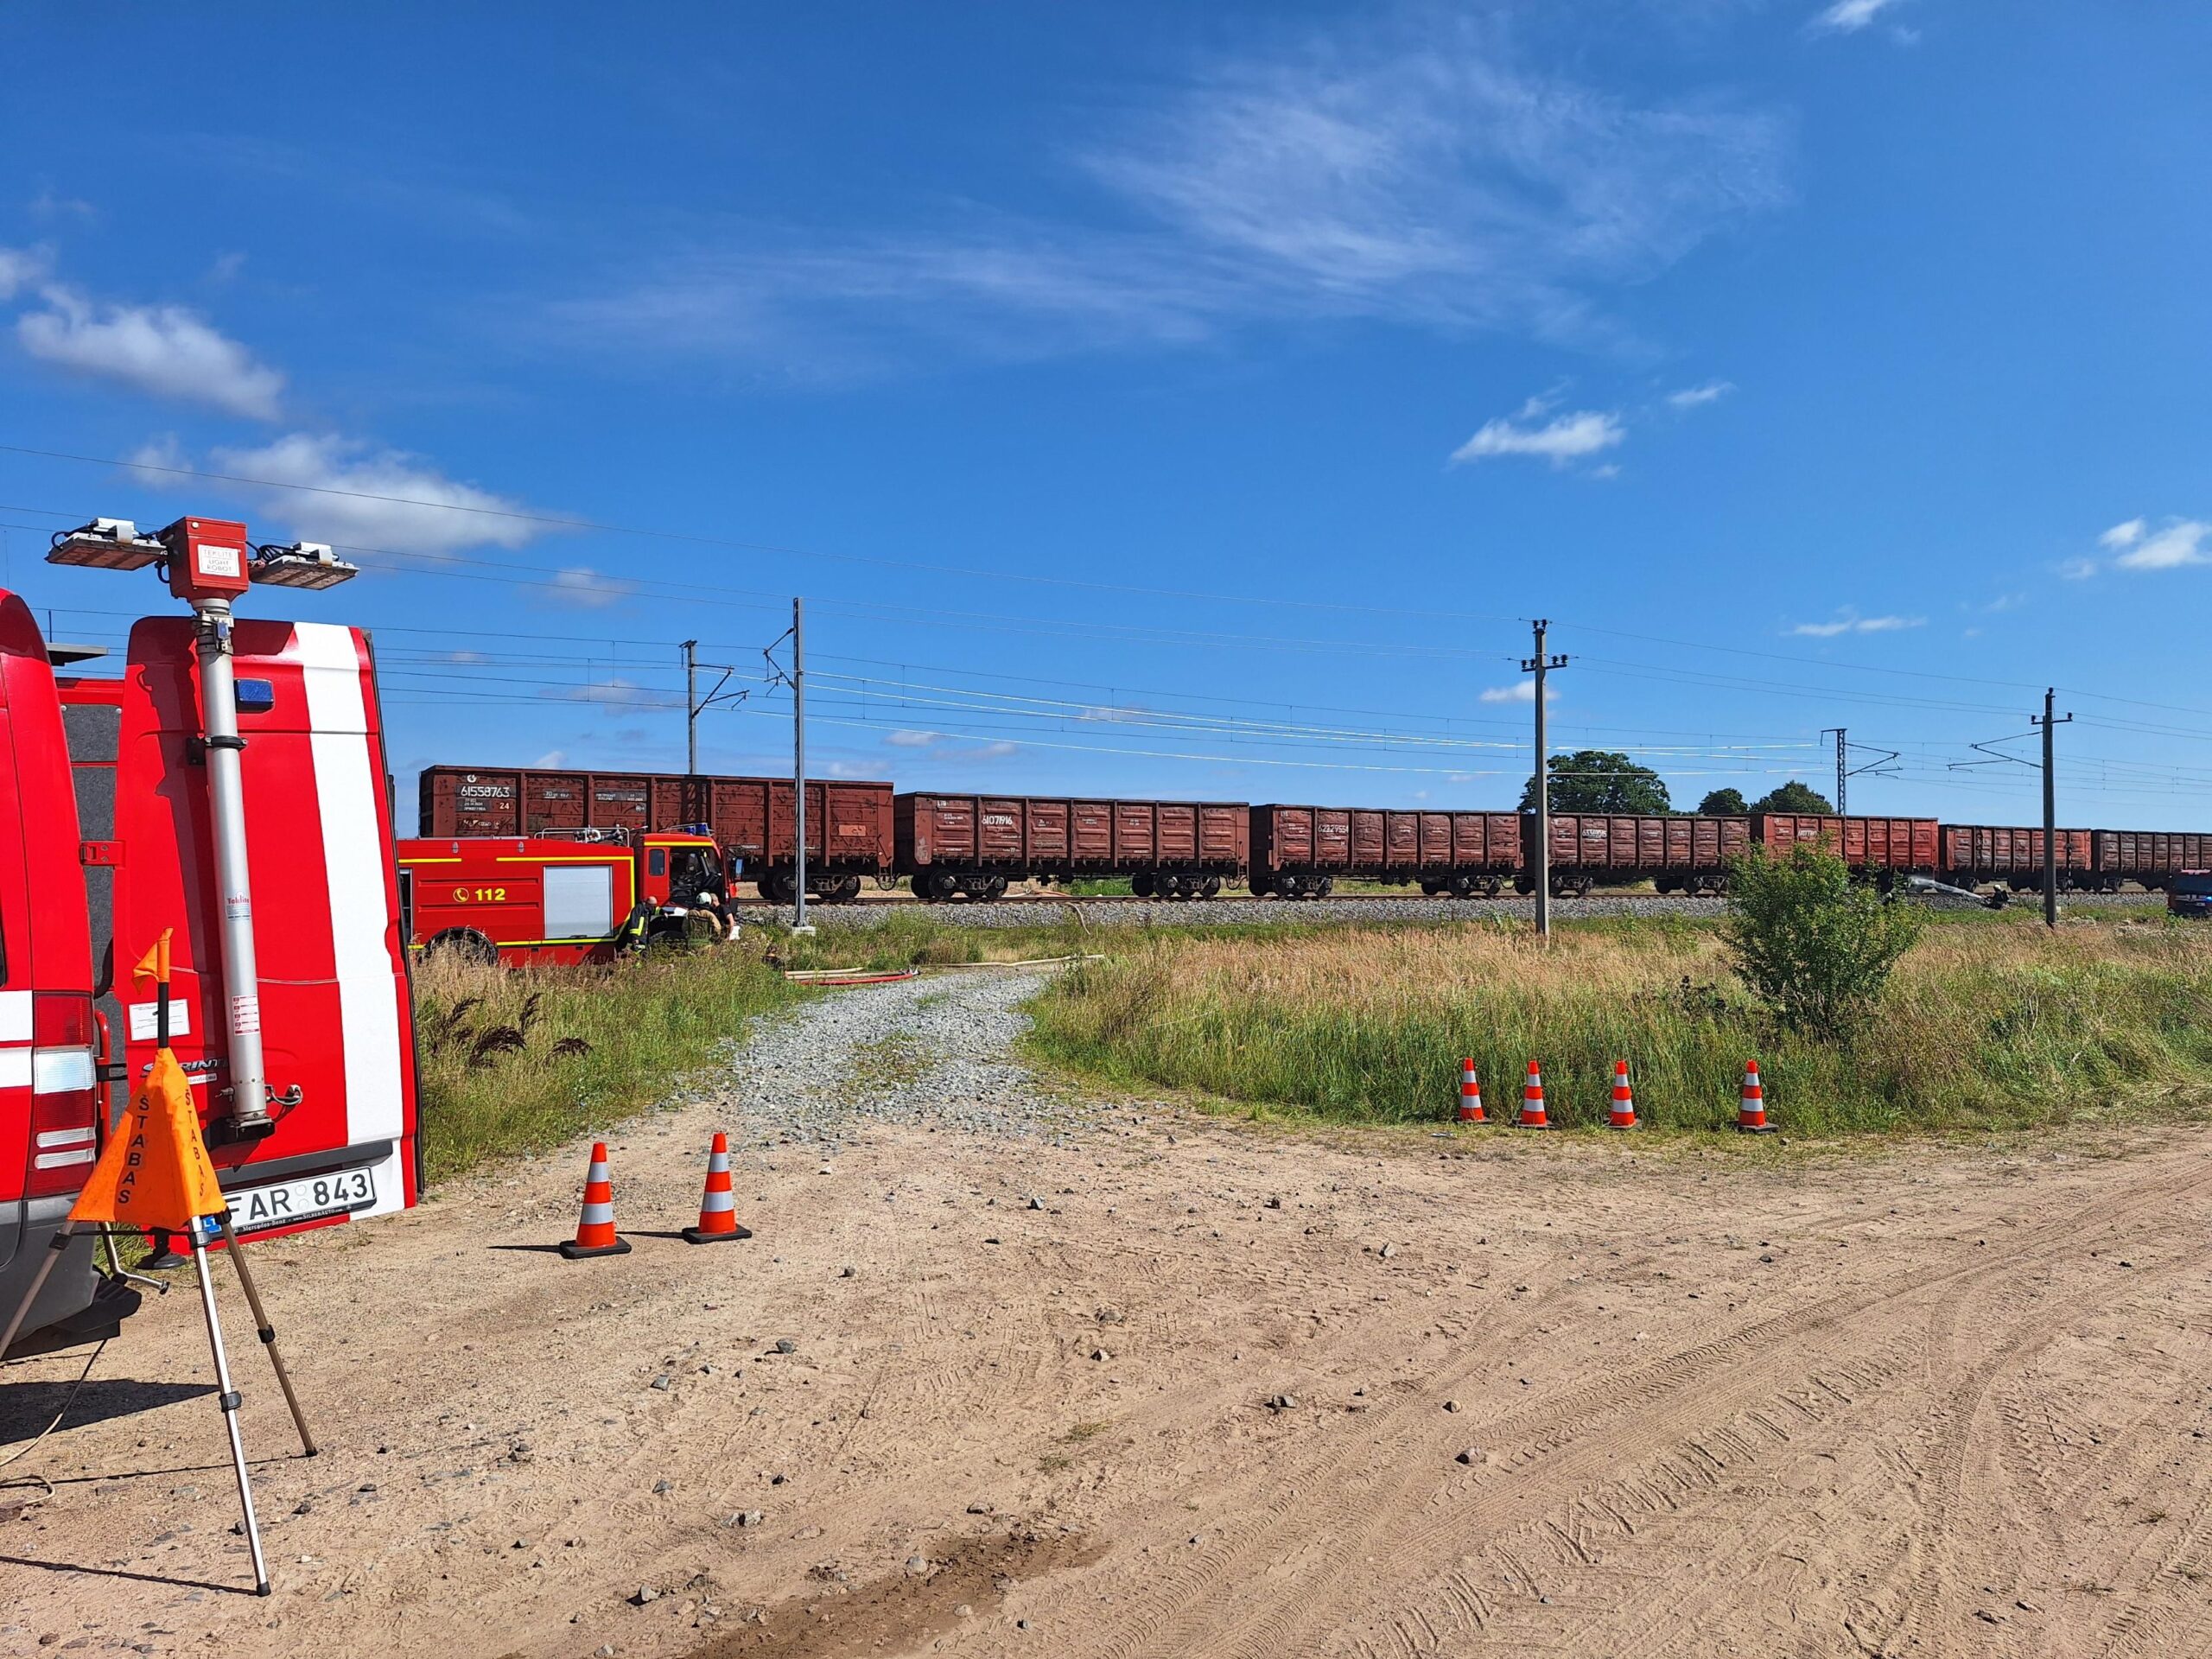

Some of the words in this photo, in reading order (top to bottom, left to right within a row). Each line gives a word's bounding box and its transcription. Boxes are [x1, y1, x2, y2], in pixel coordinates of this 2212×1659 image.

[461, 785, 511, 798] 61558763
[982, 815, 1014, 826] 61071916
[474, 888, 505, 901] 112
[118, 1094, 149, 1204] ŠTABAS
[185, 1089, 207, 1197] ŠTABAS
[313, 1173, 368, 1206] 843
[242, 1217, 287, 1231] Mercedes-Benz
